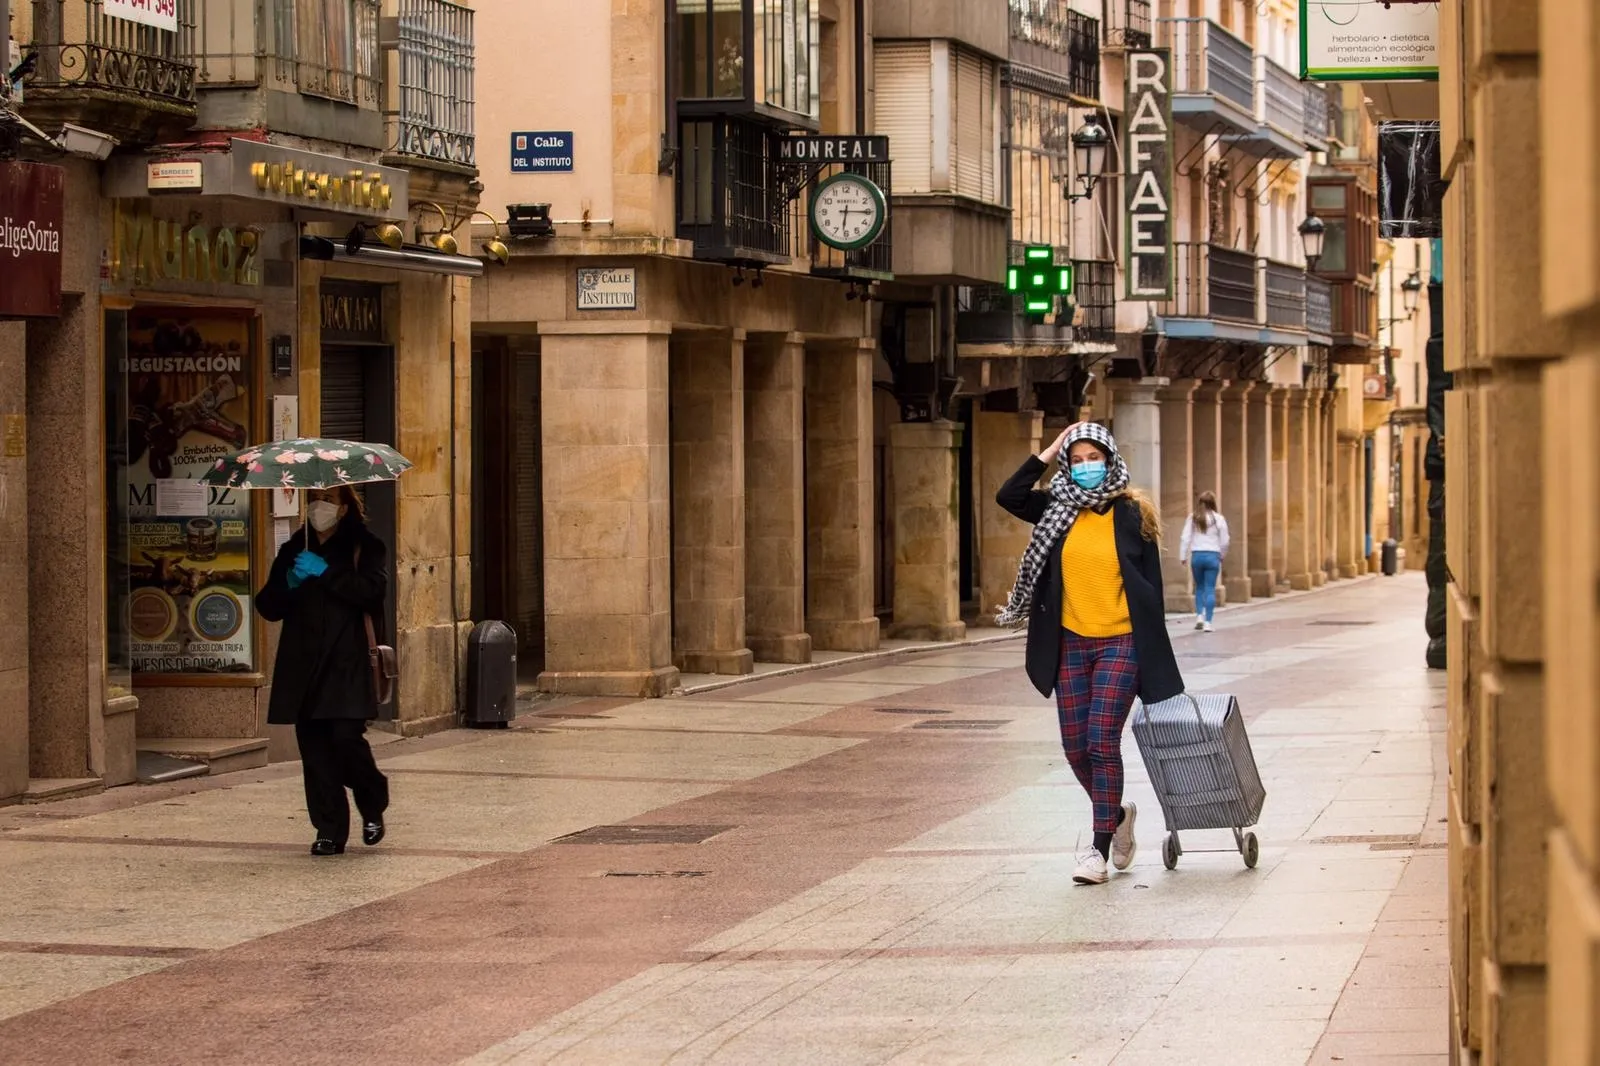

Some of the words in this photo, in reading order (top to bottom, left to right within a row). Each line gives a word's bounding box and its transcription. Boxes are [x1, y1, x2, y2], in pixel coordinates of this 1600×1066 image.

[1332, 34, 1380, 43] herbolario
[1390, 33, 1430, 42] dietética
[1327, 45, 1388, 53] alimentación
[1389, 43, 1436, 53] ecológica
[1337, 55, 1371, 63] belleza
[1382, 54, 1426, 63] bienestar
[534, 136, 564, 148] Calle
[780, 140, 877, 159] MONREAL
[513, 157, 529, 167] DEL
[532, 156, 572, 167] INSTITUTO
[1128, 52, 1168, 296] RAFAEL
[824, 198, 834, 206] 10
[862, 197, 869, 205] 2
[834, 227, 840, 235] 7
[844, 230, 850, 238] 6
[854, 227, 861, 235] 5
[601, 274, 631, 284] CALLE
[582, 289, 634, 305] INSTITUTO
[118, 353, 241, 373] DEGUSTACIÓN
[173, 455, 198, 466] 100%
